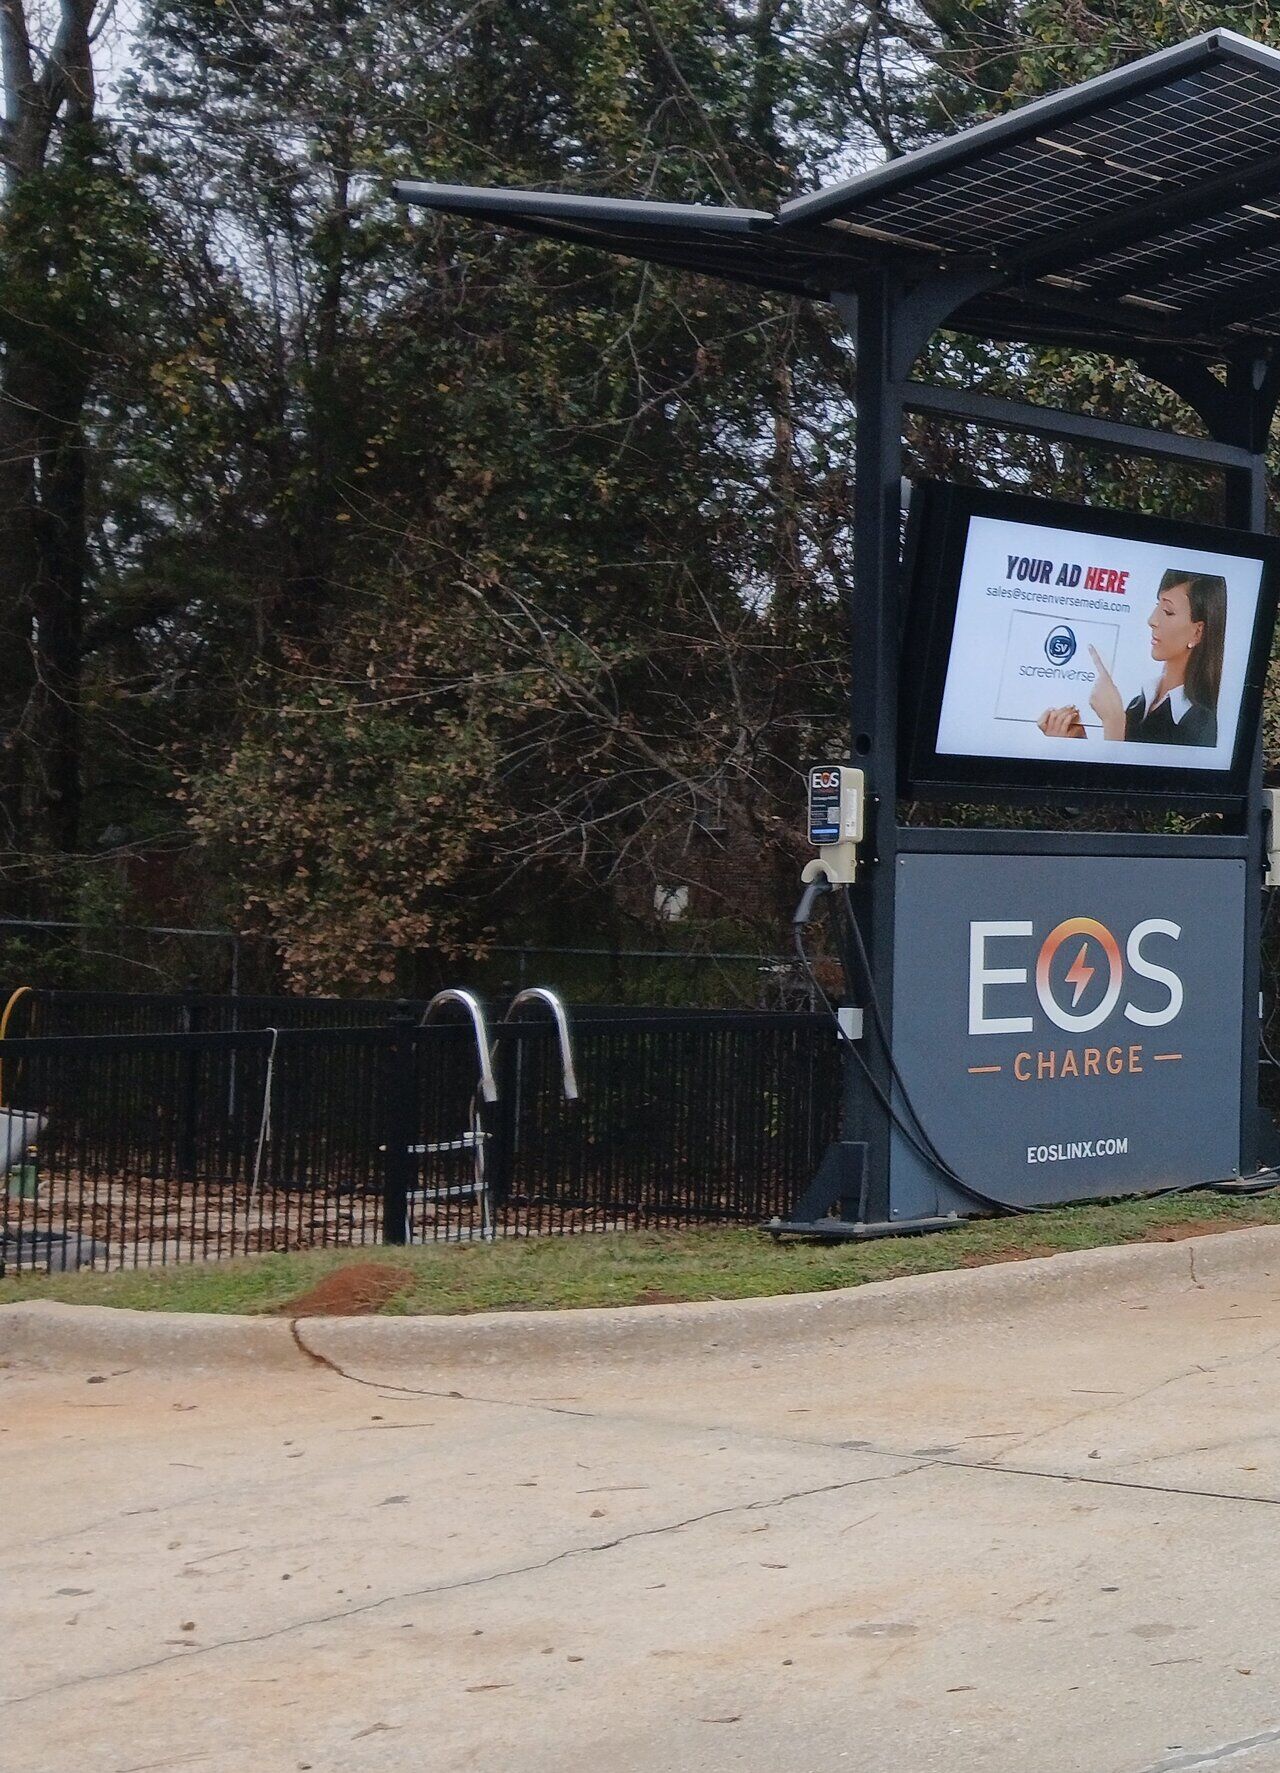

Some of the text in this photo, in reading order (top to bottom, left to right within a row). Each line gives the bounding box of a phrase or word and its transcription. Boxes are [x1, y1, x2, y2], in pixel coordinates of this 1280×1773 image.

[1005, 555, 1130, 595] YOUR AD HERE
[986, 586, 1131, 613] sales@screenversemedia.com
[1019, 665, 1096, 682] screenverse
[812, 772, 840, 788] EOS
[968, 917, 1184, 1035] EOS
[1013, 1045, 1143, 1081] CHARGE
[1027, 1137, 1129, 1164] EOSLINX.COM
